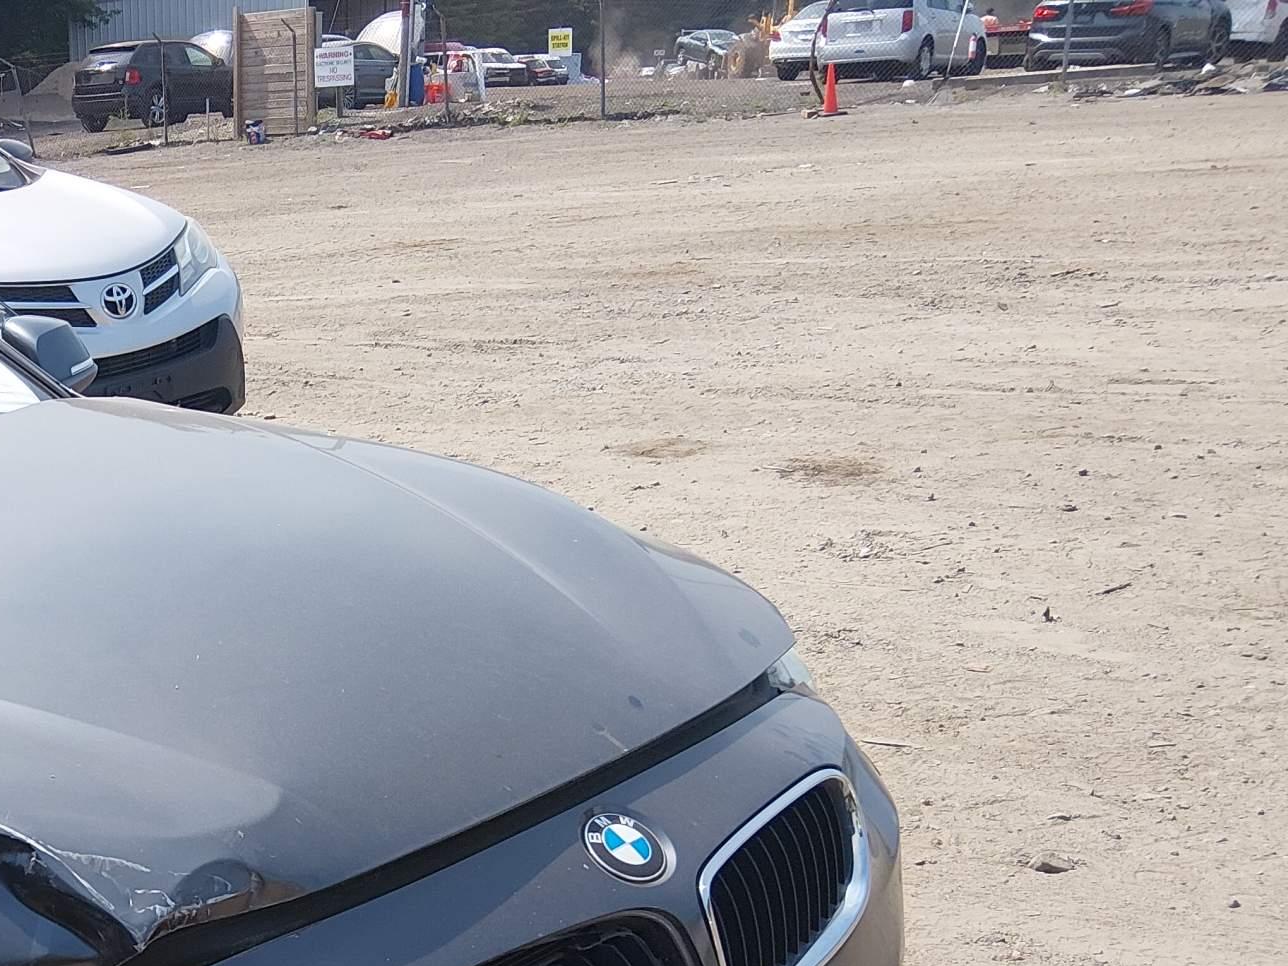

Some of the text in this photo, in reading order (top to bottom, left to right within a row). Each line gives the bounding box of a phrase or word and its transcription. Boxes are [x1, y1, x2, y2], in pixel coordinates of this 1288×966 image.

[318, 50, 349, 59] WARNING
[329, 66, 338, 74] NO
[317, 73, 353, 82] TRESPASSING
[588, 815, 635, 844] BMW
